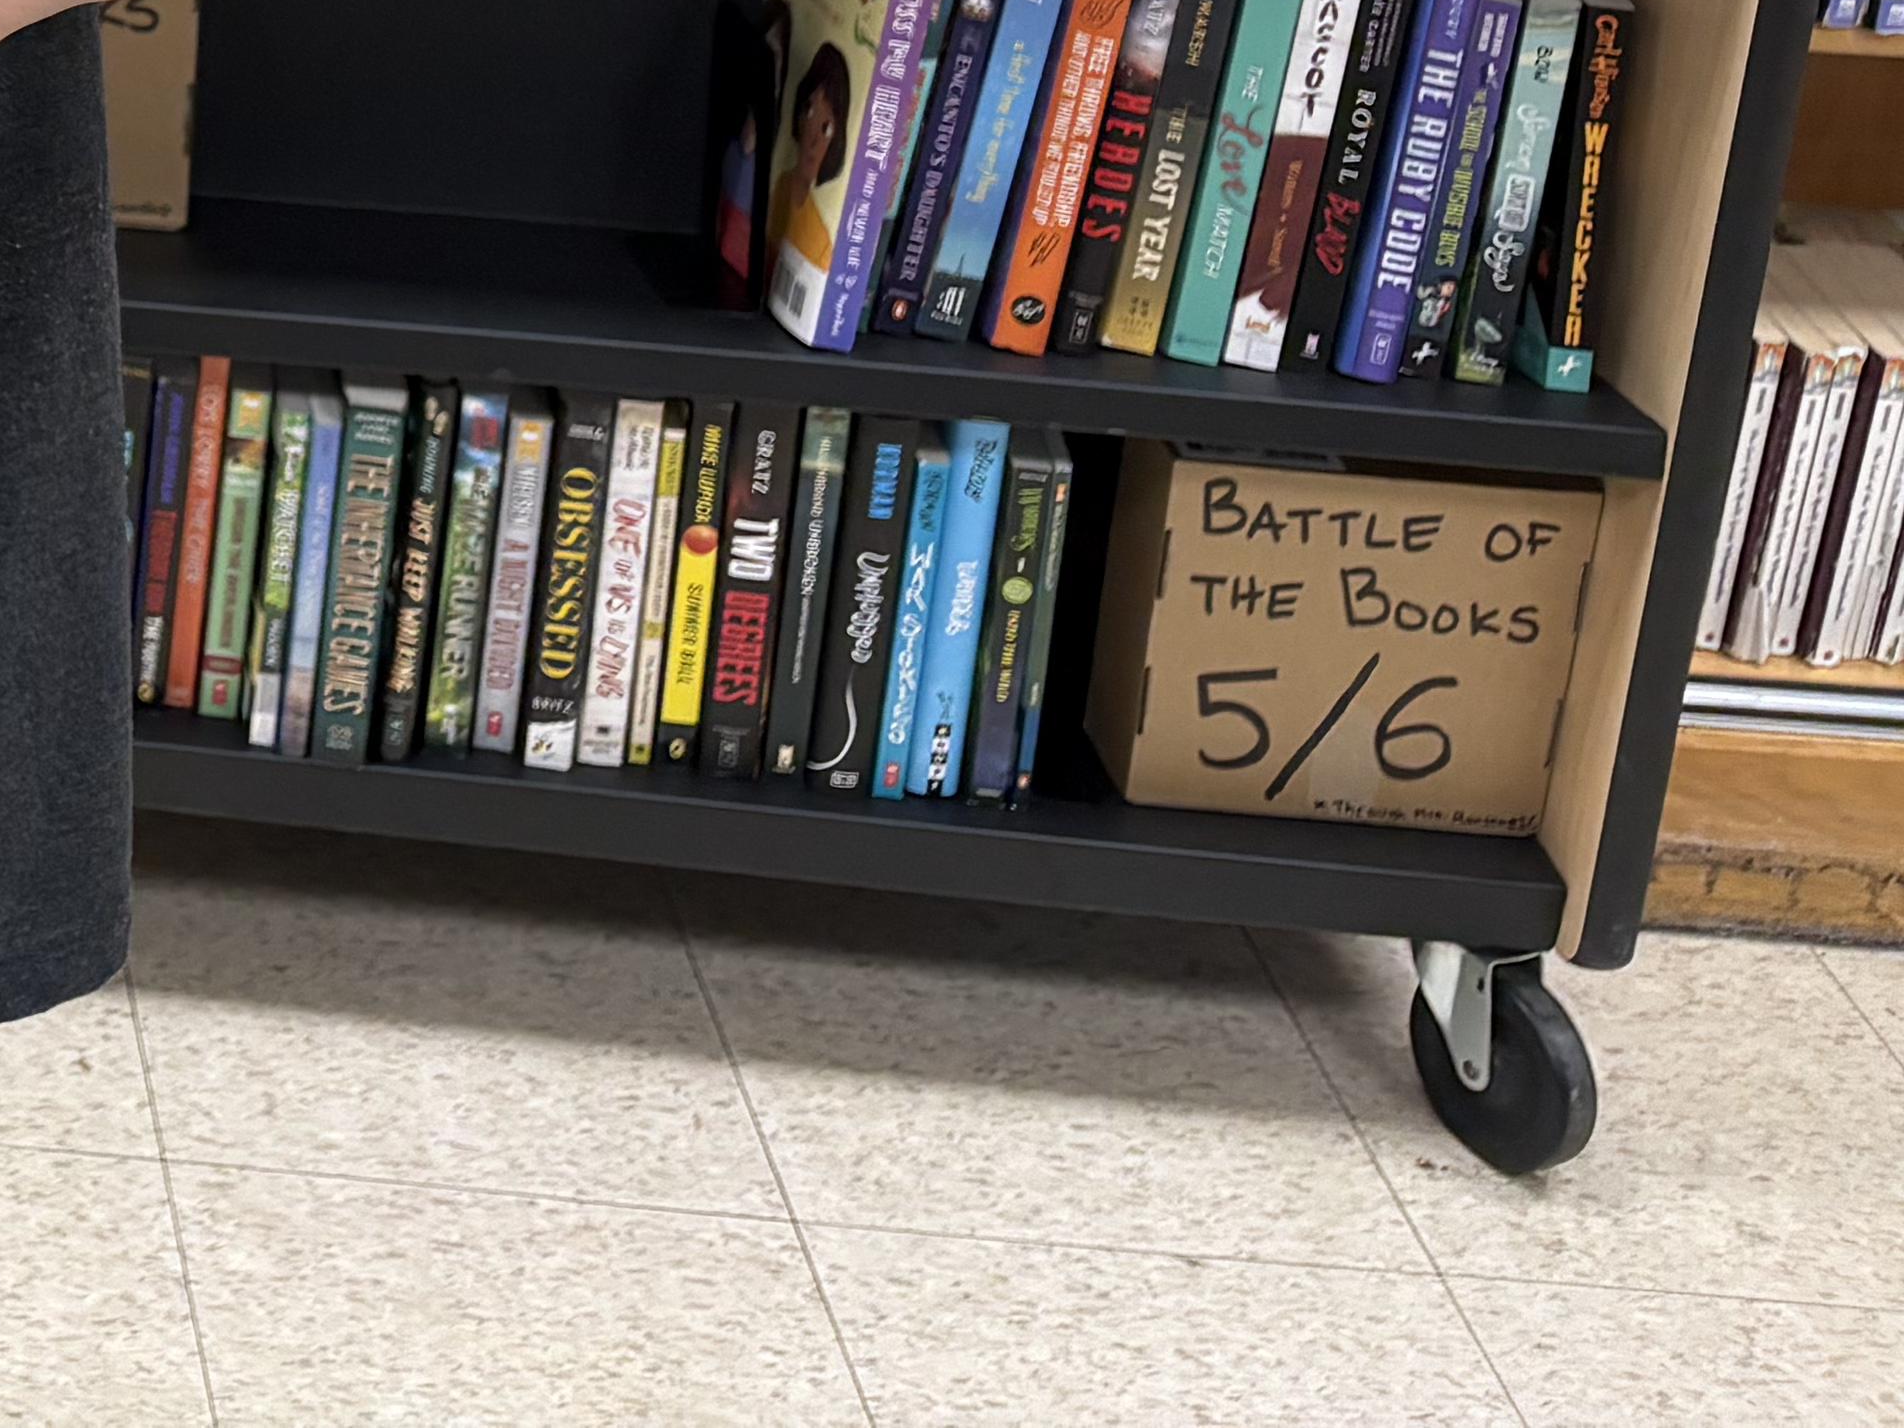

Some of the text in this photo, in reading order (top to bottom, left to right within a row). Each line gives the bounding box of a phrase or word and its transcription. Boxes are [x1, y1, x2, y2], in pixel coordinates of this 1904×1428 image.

[898, 53, 974, 282] ENCANTO'S DAUGHTER
[1081, 89, 1154, 243] HEROES
[1147, 148, 1186, 207] LOST
[1336, 87, 1377, 186] ROYAL
[1374, 48, 1464, 296] THE RUBY CODE
[1131, 213, 1170, 282] YEAR
[1201, 202, 1235, 280] MATCH
[1563, 121, 1610, 347] WRECKER
[347, 453, 394, 497] THE
[750, 429, 778, 496] GRATZ
[407, 497, 436, 545] JUST
[608, 498, 648, 558] ONE
[1202, 476, 1562, 563] BATTLE OF
[538, 466, 598, 680] OBSESSED
[712, 517, 781, 706] TWO DEGREES
[1190, 566, 1540, 645] THE BOOKS
[440, 573, 478, 683] RUNNER
[322, 636, 375, 716] GAMES
[1197, 651, 1459, 802] 5/6
